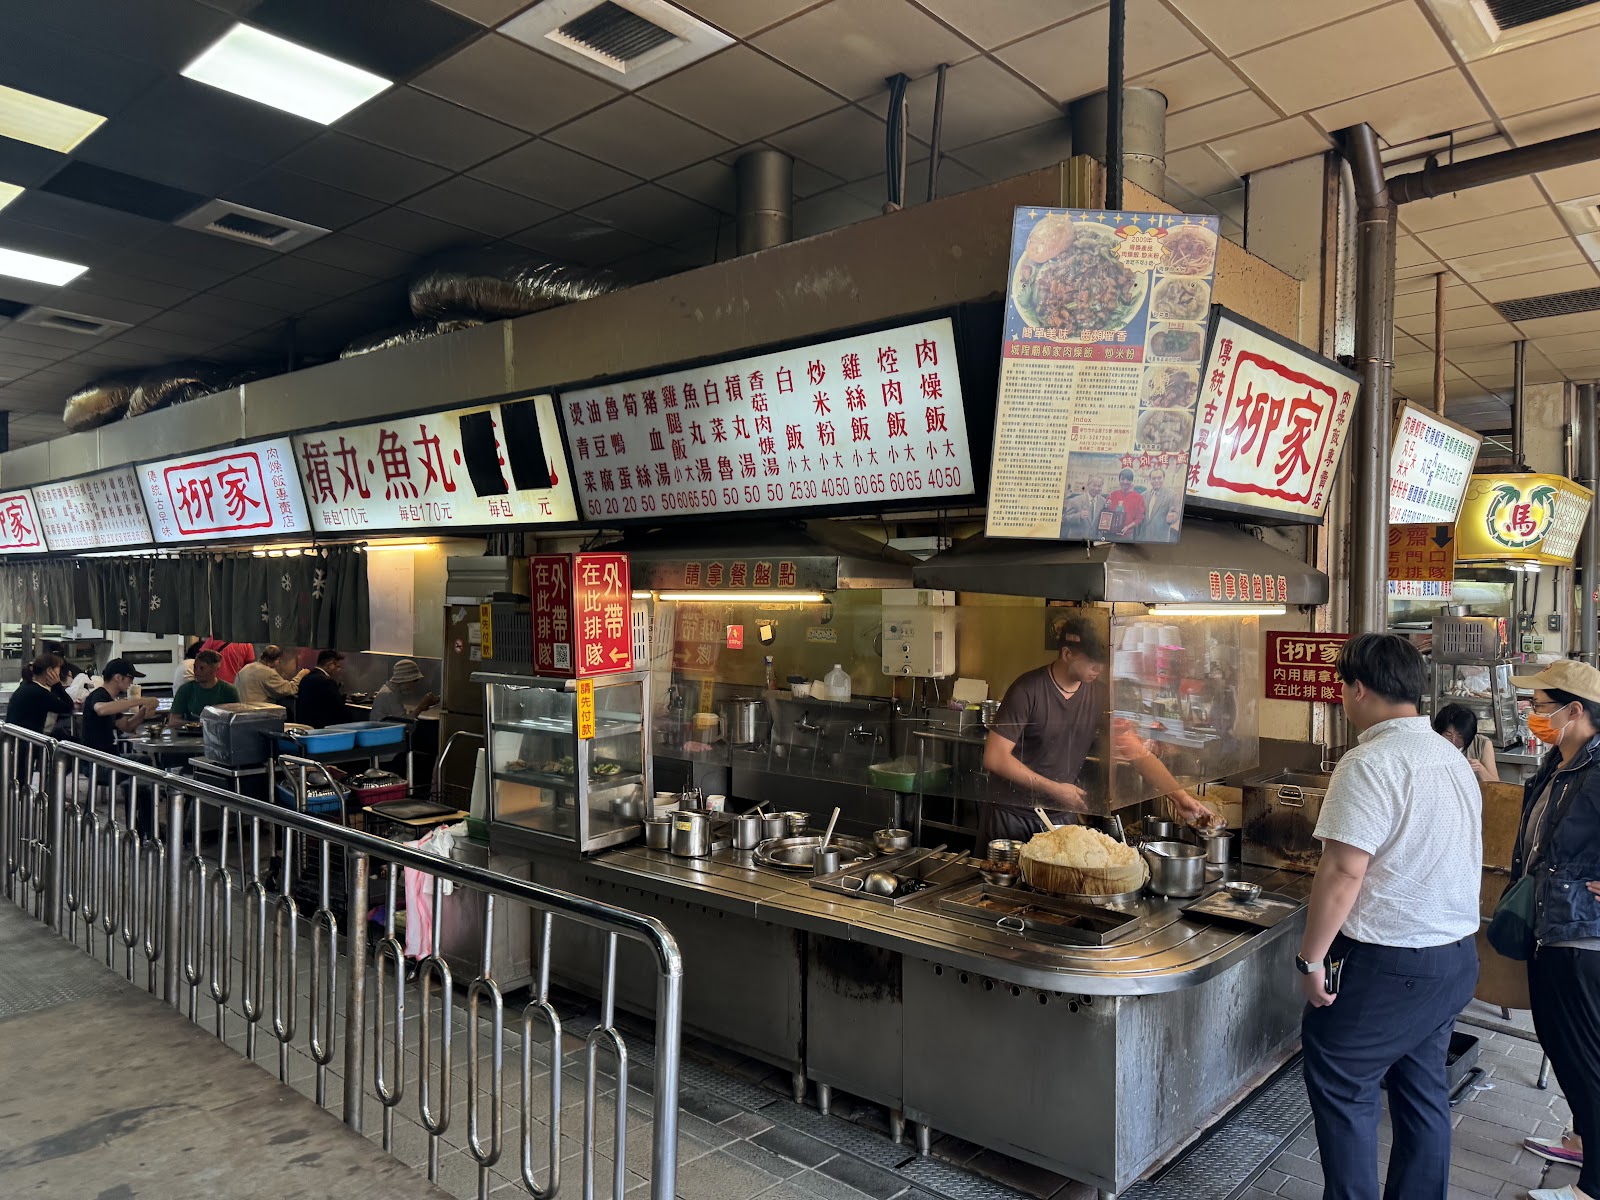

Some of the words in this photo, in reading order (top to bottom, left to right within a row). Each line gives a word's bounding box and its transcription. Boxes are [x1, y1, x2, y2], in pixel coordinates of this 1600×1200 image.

[1022, 326, 1069, 340] 簡單美味
[1080, 329, 1128, 343] 齒頰留香
[1225, 381, 1324, 487] 柳家
[175, 463, 261, 526] 柳家
[322, 508, 369, 526] 每包170元
[399, 502, 453, 523] 每包170元
[1506, 504, 1536, 537] 馬
[684, 561, 796, 587] 請拿餐盤點
[1209, 571, 1287, 602] 請拿餐盤點餐
[535, 563, 553, 667] 在此排隊
[551, 563, 568, 642] 外帶
[582, 562, 604, 667] 在此排隊
[602, 561, 624, 640] 外帶
[1281, 640, 1343, 663] 柳家
[580, 682, 592, 736] 請先付款
[1273, 683, 1335, 699] 在此排隊
